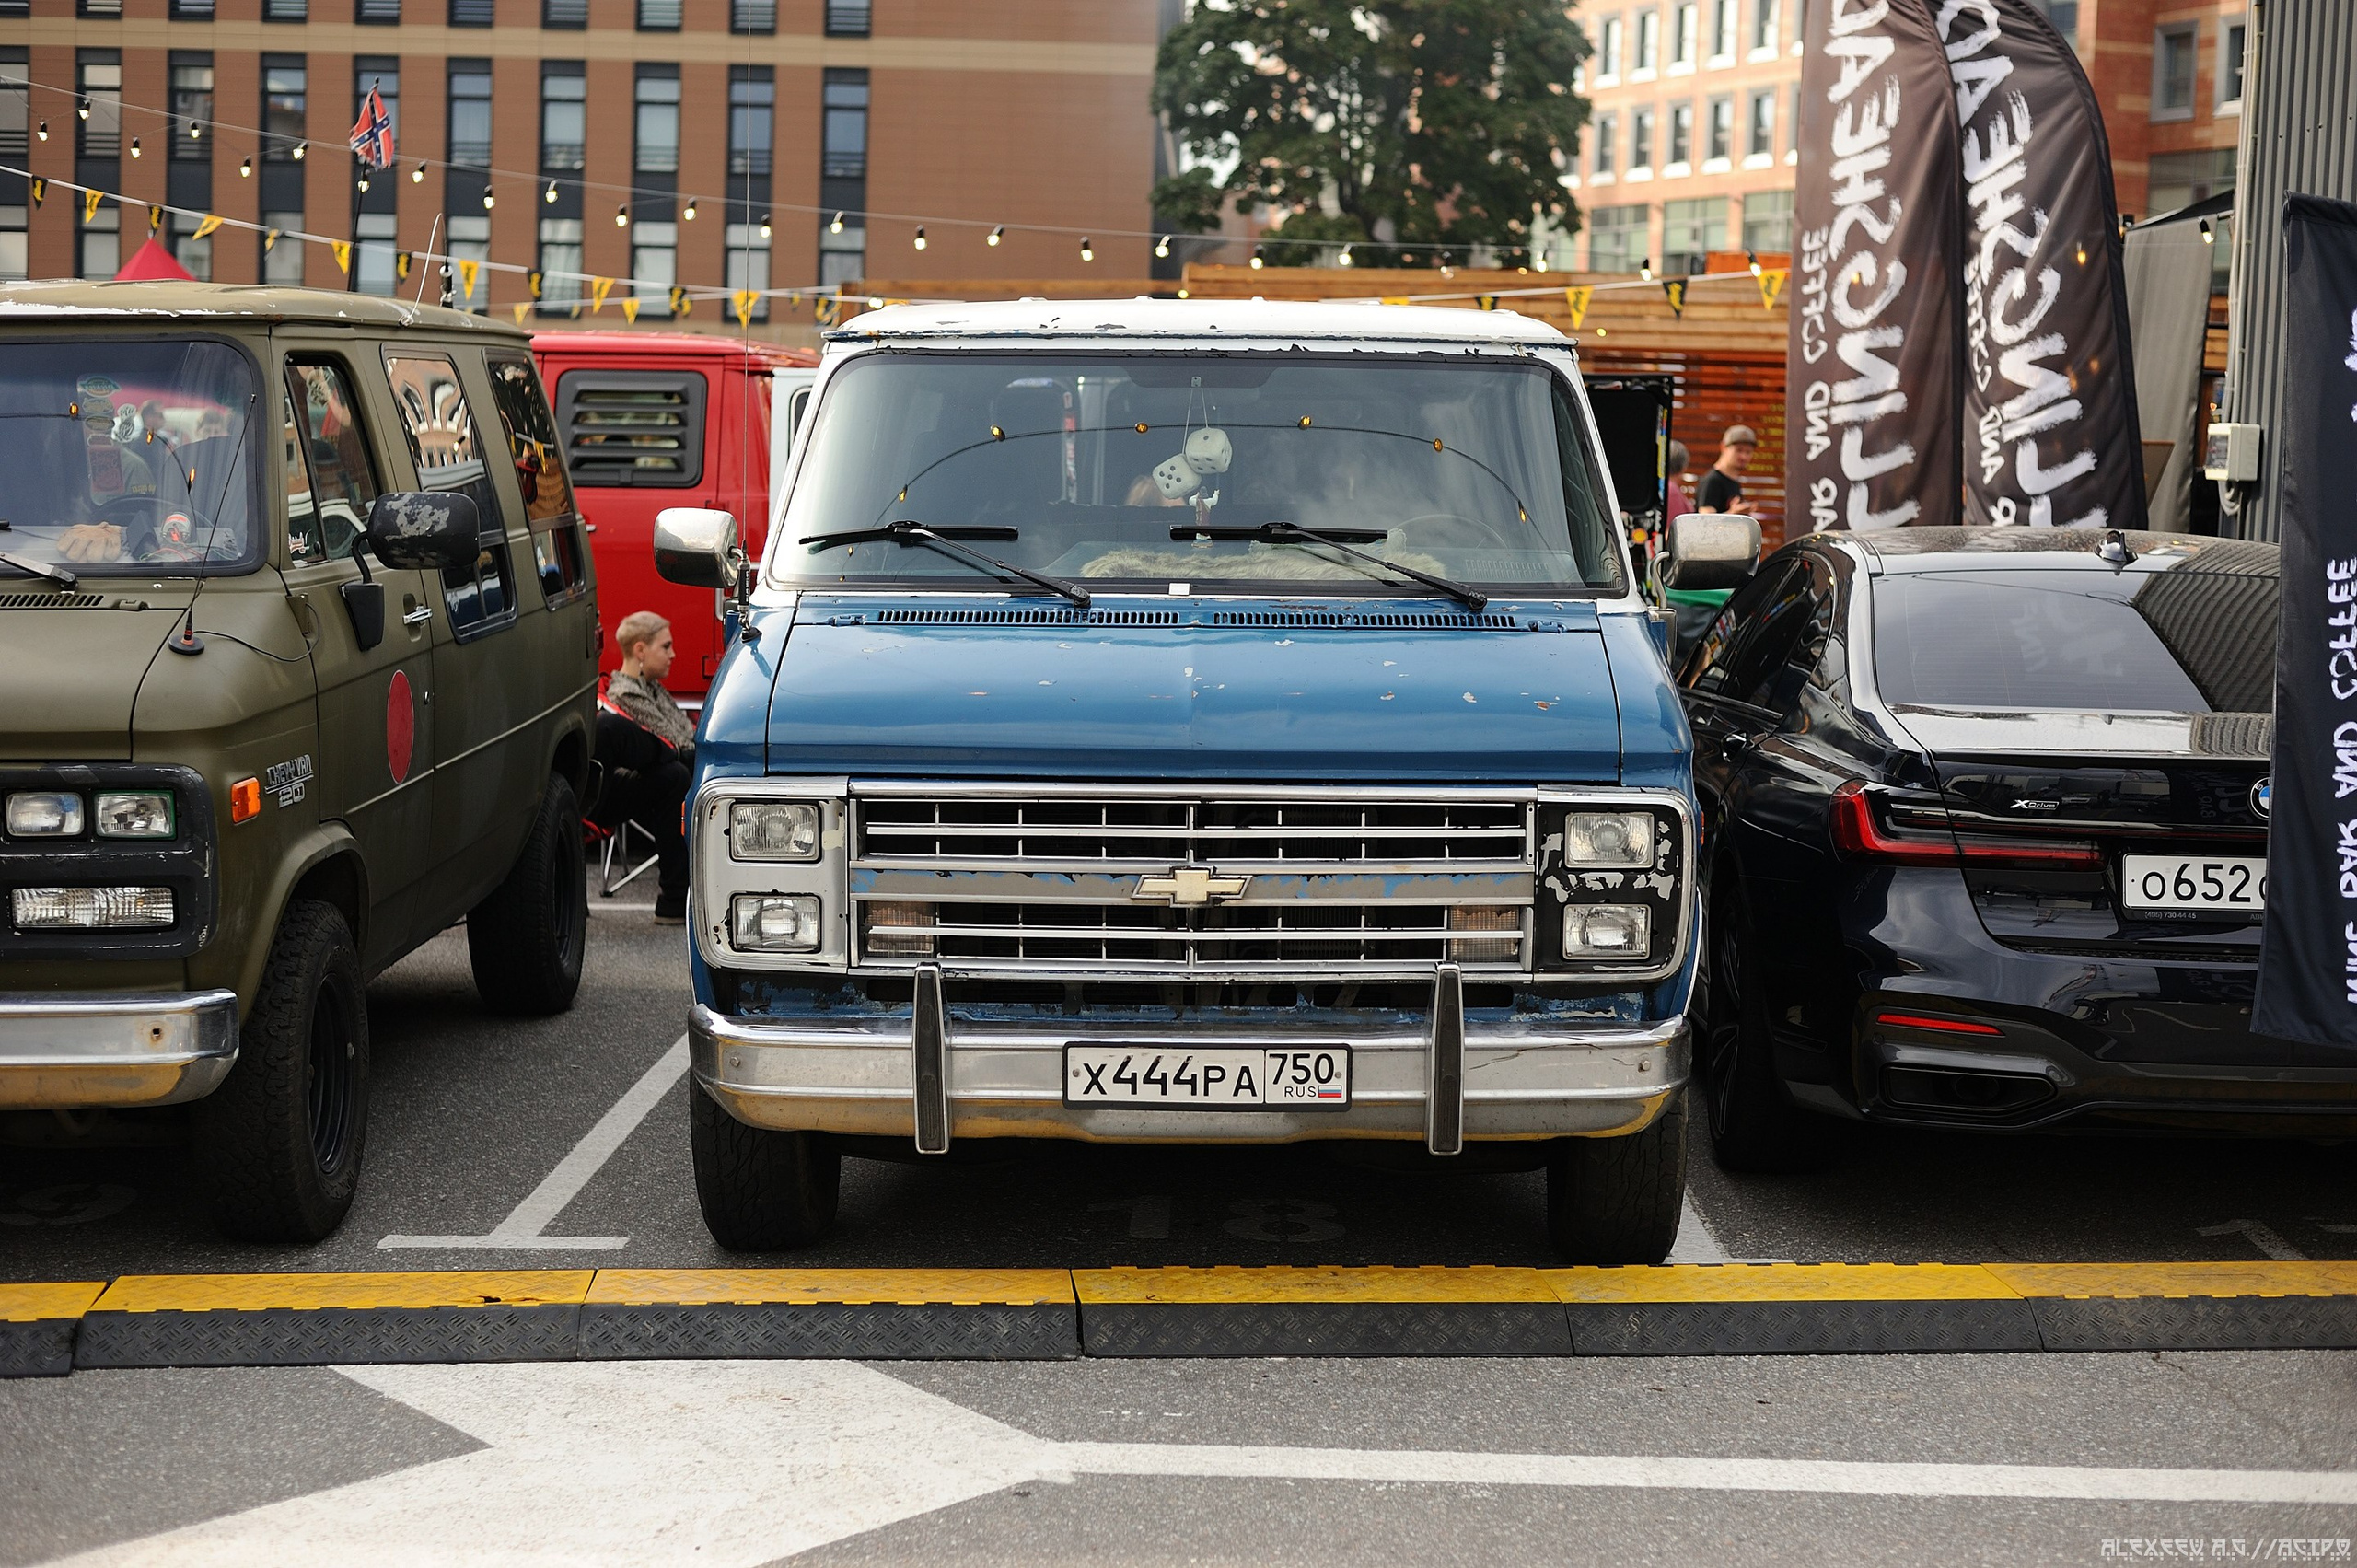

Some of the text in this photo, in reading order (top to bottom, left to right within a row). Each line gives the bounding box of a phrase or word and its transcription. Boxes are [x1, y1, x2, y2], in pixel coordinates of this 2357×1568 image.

[266, 753, 314, 785] CHEVY VAN
[279, 783, 305, 808] 20
[2164, 911, 2177, 919] 730
[1268, 1052, 1336, 1086] 750
[1283, 1086, 1317, 1098] RUS
